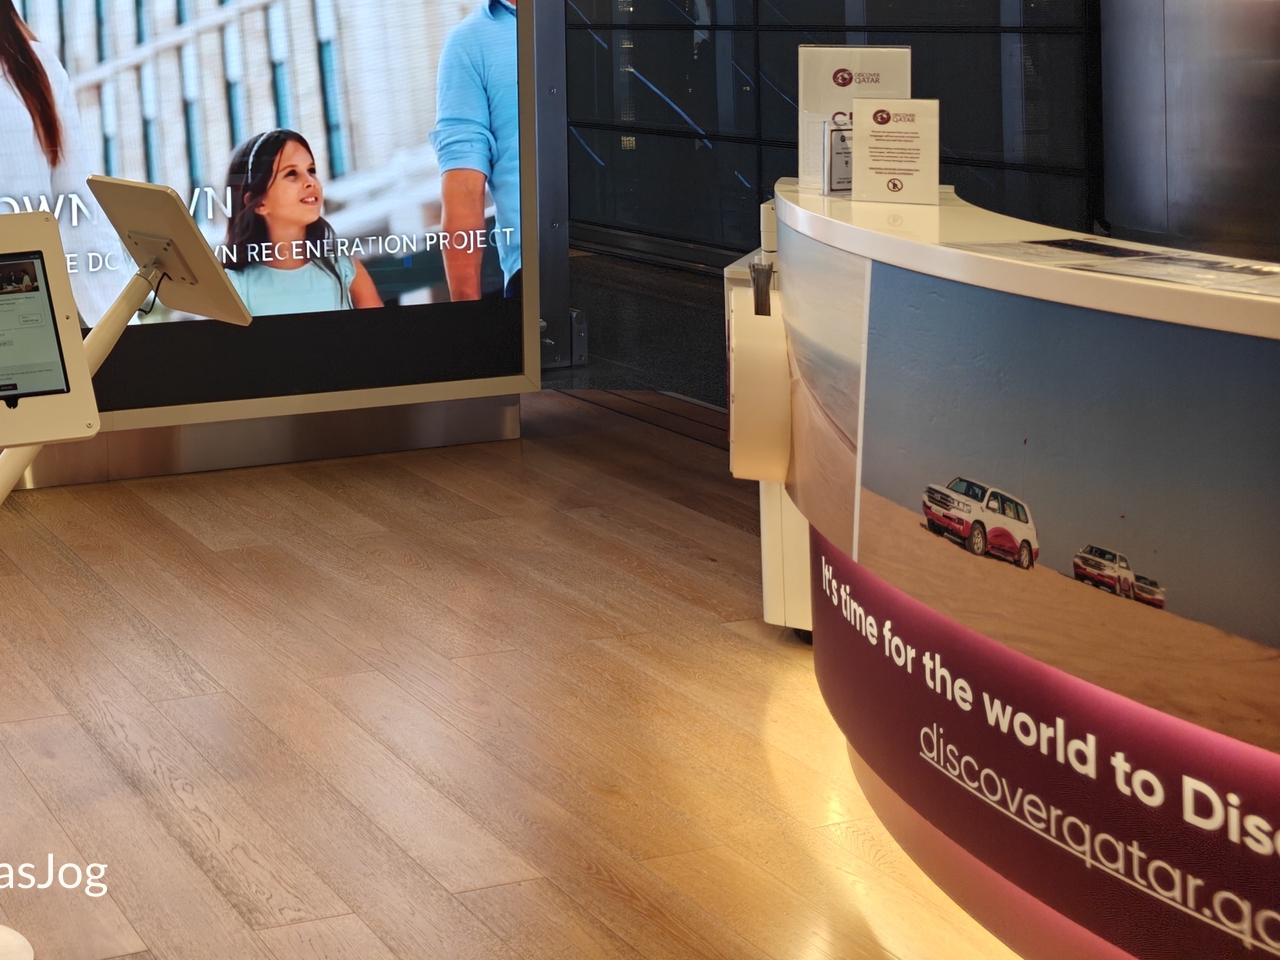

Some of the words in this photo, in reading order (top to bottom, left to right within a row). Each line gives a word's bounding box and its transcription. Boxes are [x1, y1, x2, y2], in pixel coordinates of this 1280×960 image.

[247, 233, 418, 262] REGENERATION
[425, 227, 515, 253] PROJECT
[821, 556, 838, 607] It's
[840, 584, 878, 646] time
[883, 619, 916, 674] for
[923, 651, 973, 711] the
[982, 691, 1097, 779] world
[1110, 750, 1165, 808] to
